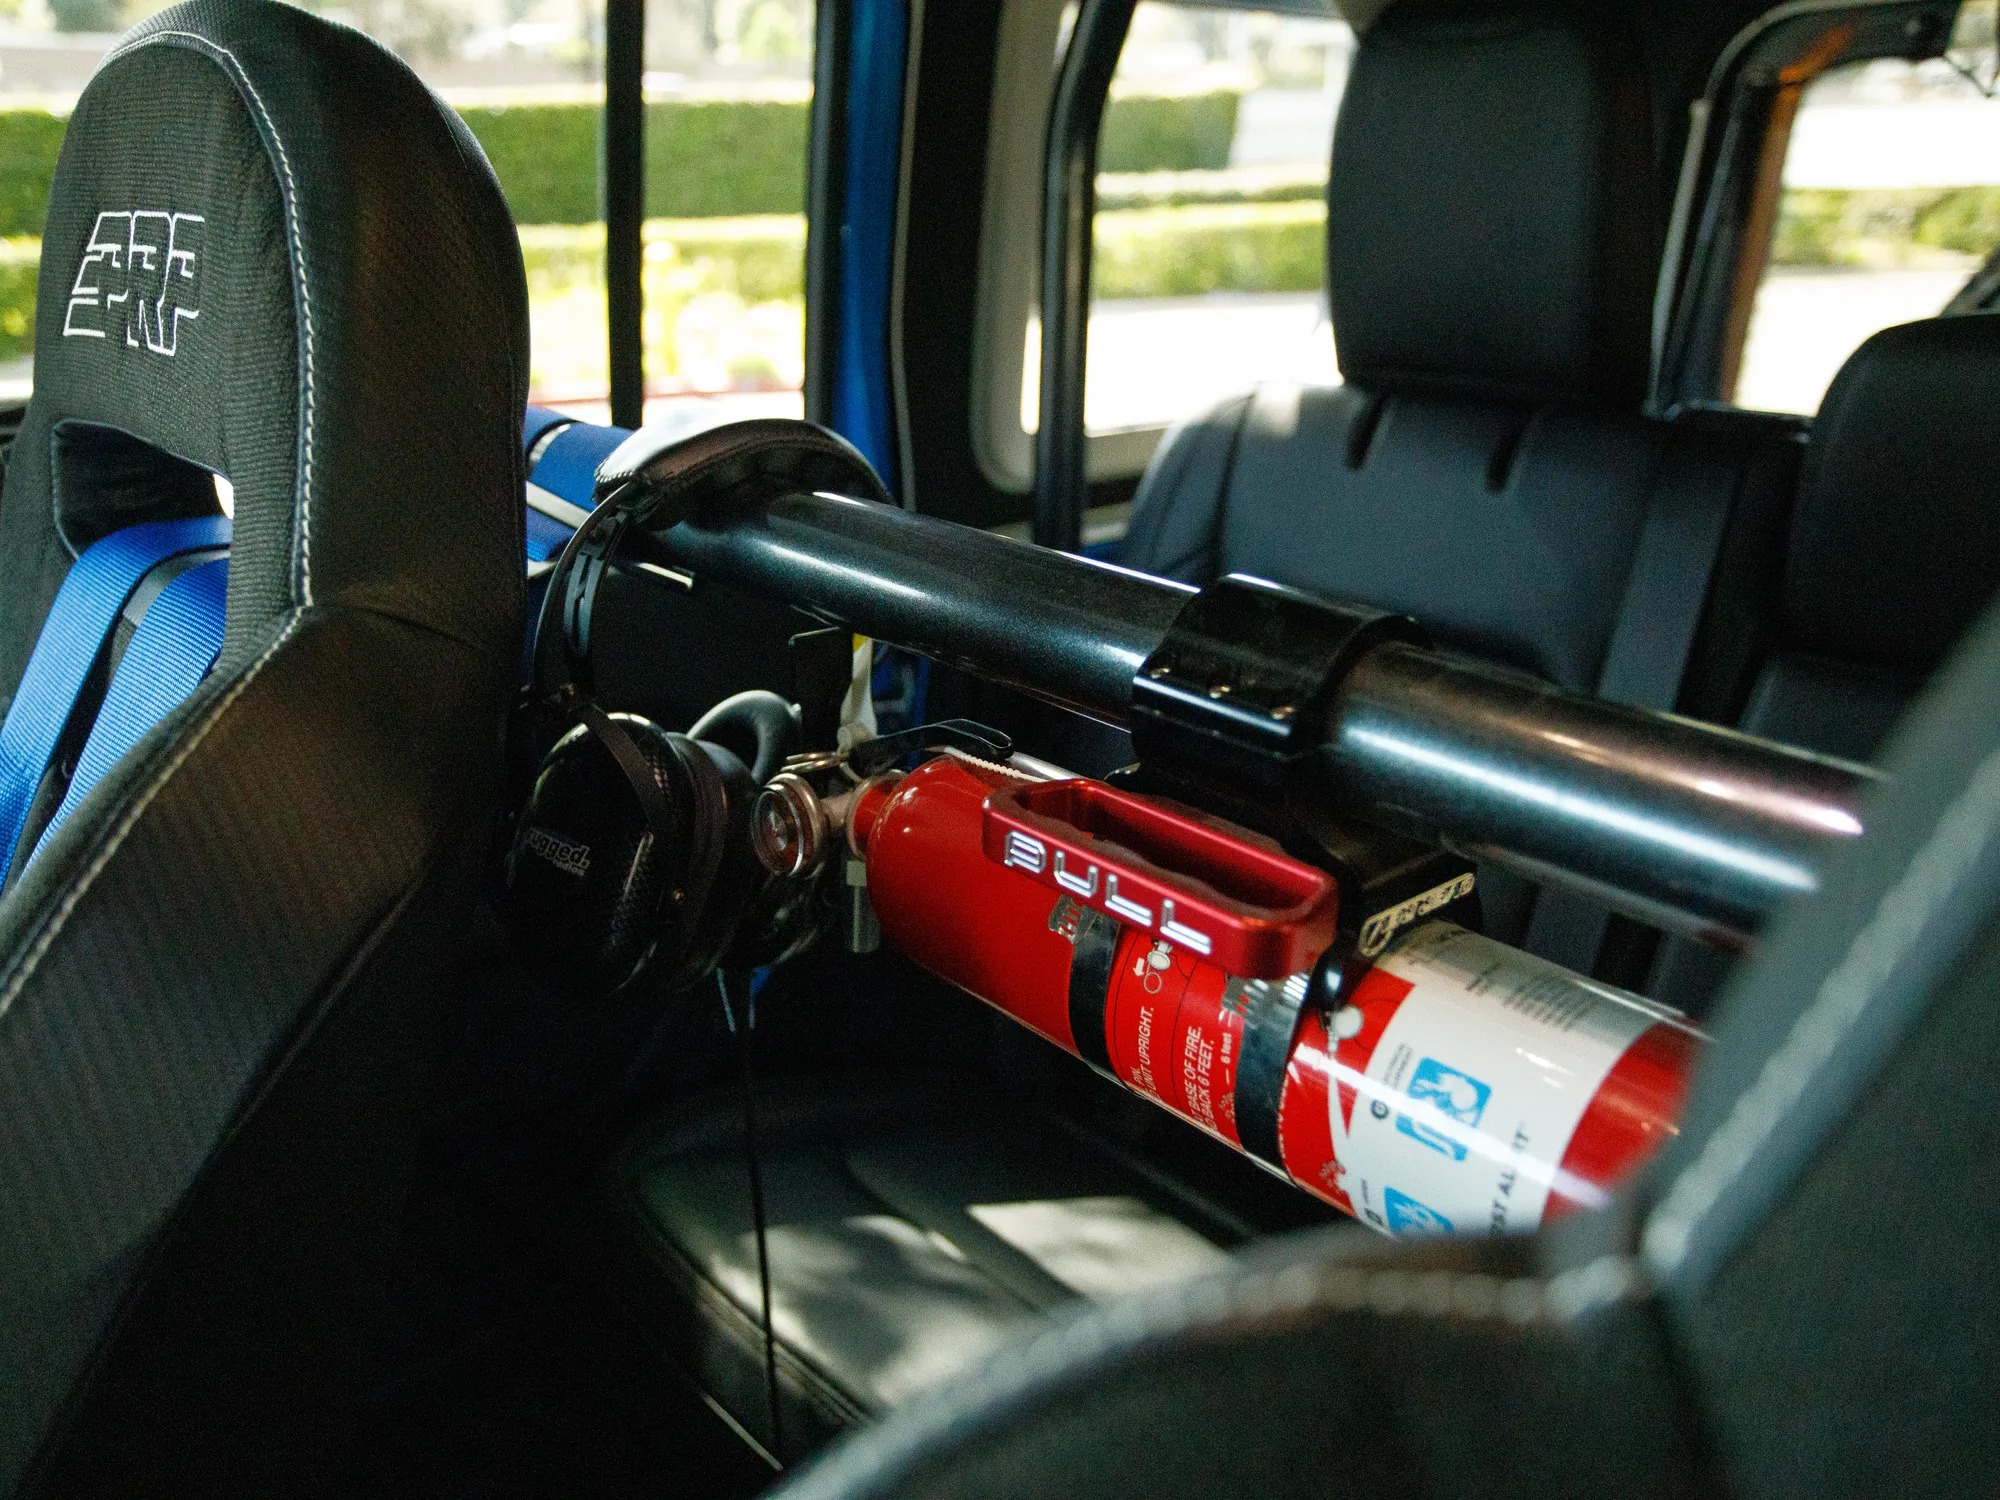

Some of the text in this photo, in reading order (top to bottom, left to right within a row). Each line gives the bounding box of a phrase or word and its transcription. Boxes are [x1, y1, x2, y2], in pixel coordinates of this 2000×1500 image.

[1004, 830, 1212, 955] PULL
[1138, 1005, 1155, 1065] UPRIGHT.
[1185, 1026, 1202, 1061] FIRE.
[1184, 1059, 1197, 1080] OF
[1198, 1038, 1214, 1077] FEET.
[1140, 1063, 1157, 1091] UNIT
[1197, 1075, 1210, 1087] 6
[1185, 1079, 1201, 1111] BASE
[1198, 1085, 1214, 1120] BACK
